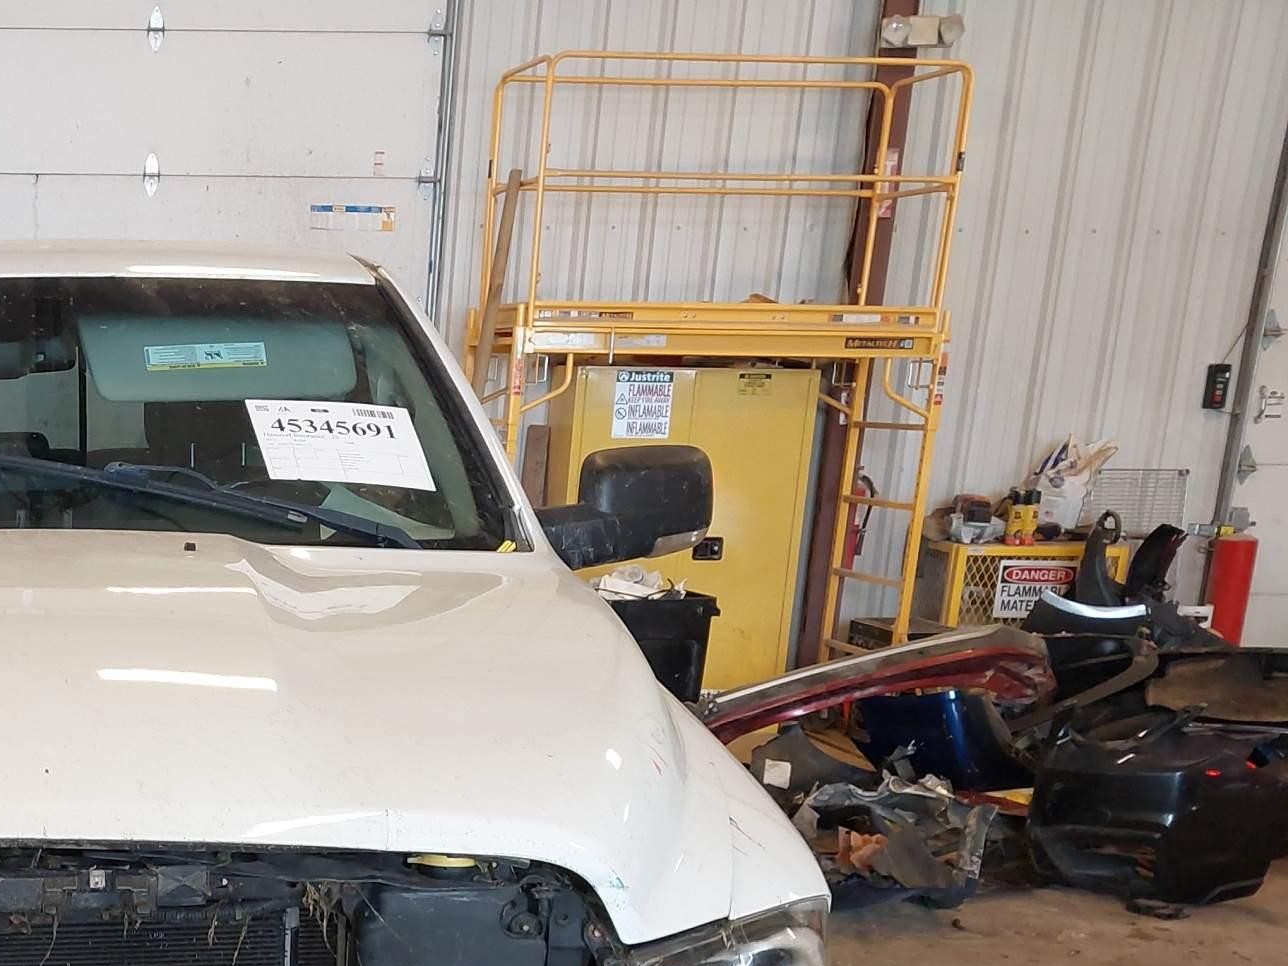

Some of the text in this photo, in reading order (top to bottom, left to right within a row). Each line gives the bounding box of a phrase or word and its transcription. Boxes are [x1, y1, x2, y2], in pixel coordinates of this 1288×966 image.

[630, 372, 671, 382] Justrite
[628, 384, 671, 397] FLAMMABLE
[627, 404, 669, 417] INFLAMABLE
[271, 418, 397, 439] 45345691
[626, 421, 667, 434] INFLAMMABLE
[1012, 569, 1066, 581] DANGER
[1000, 585, 1069, 597] FLAMMBL
[1000, 600, 1035, 612] MATE
